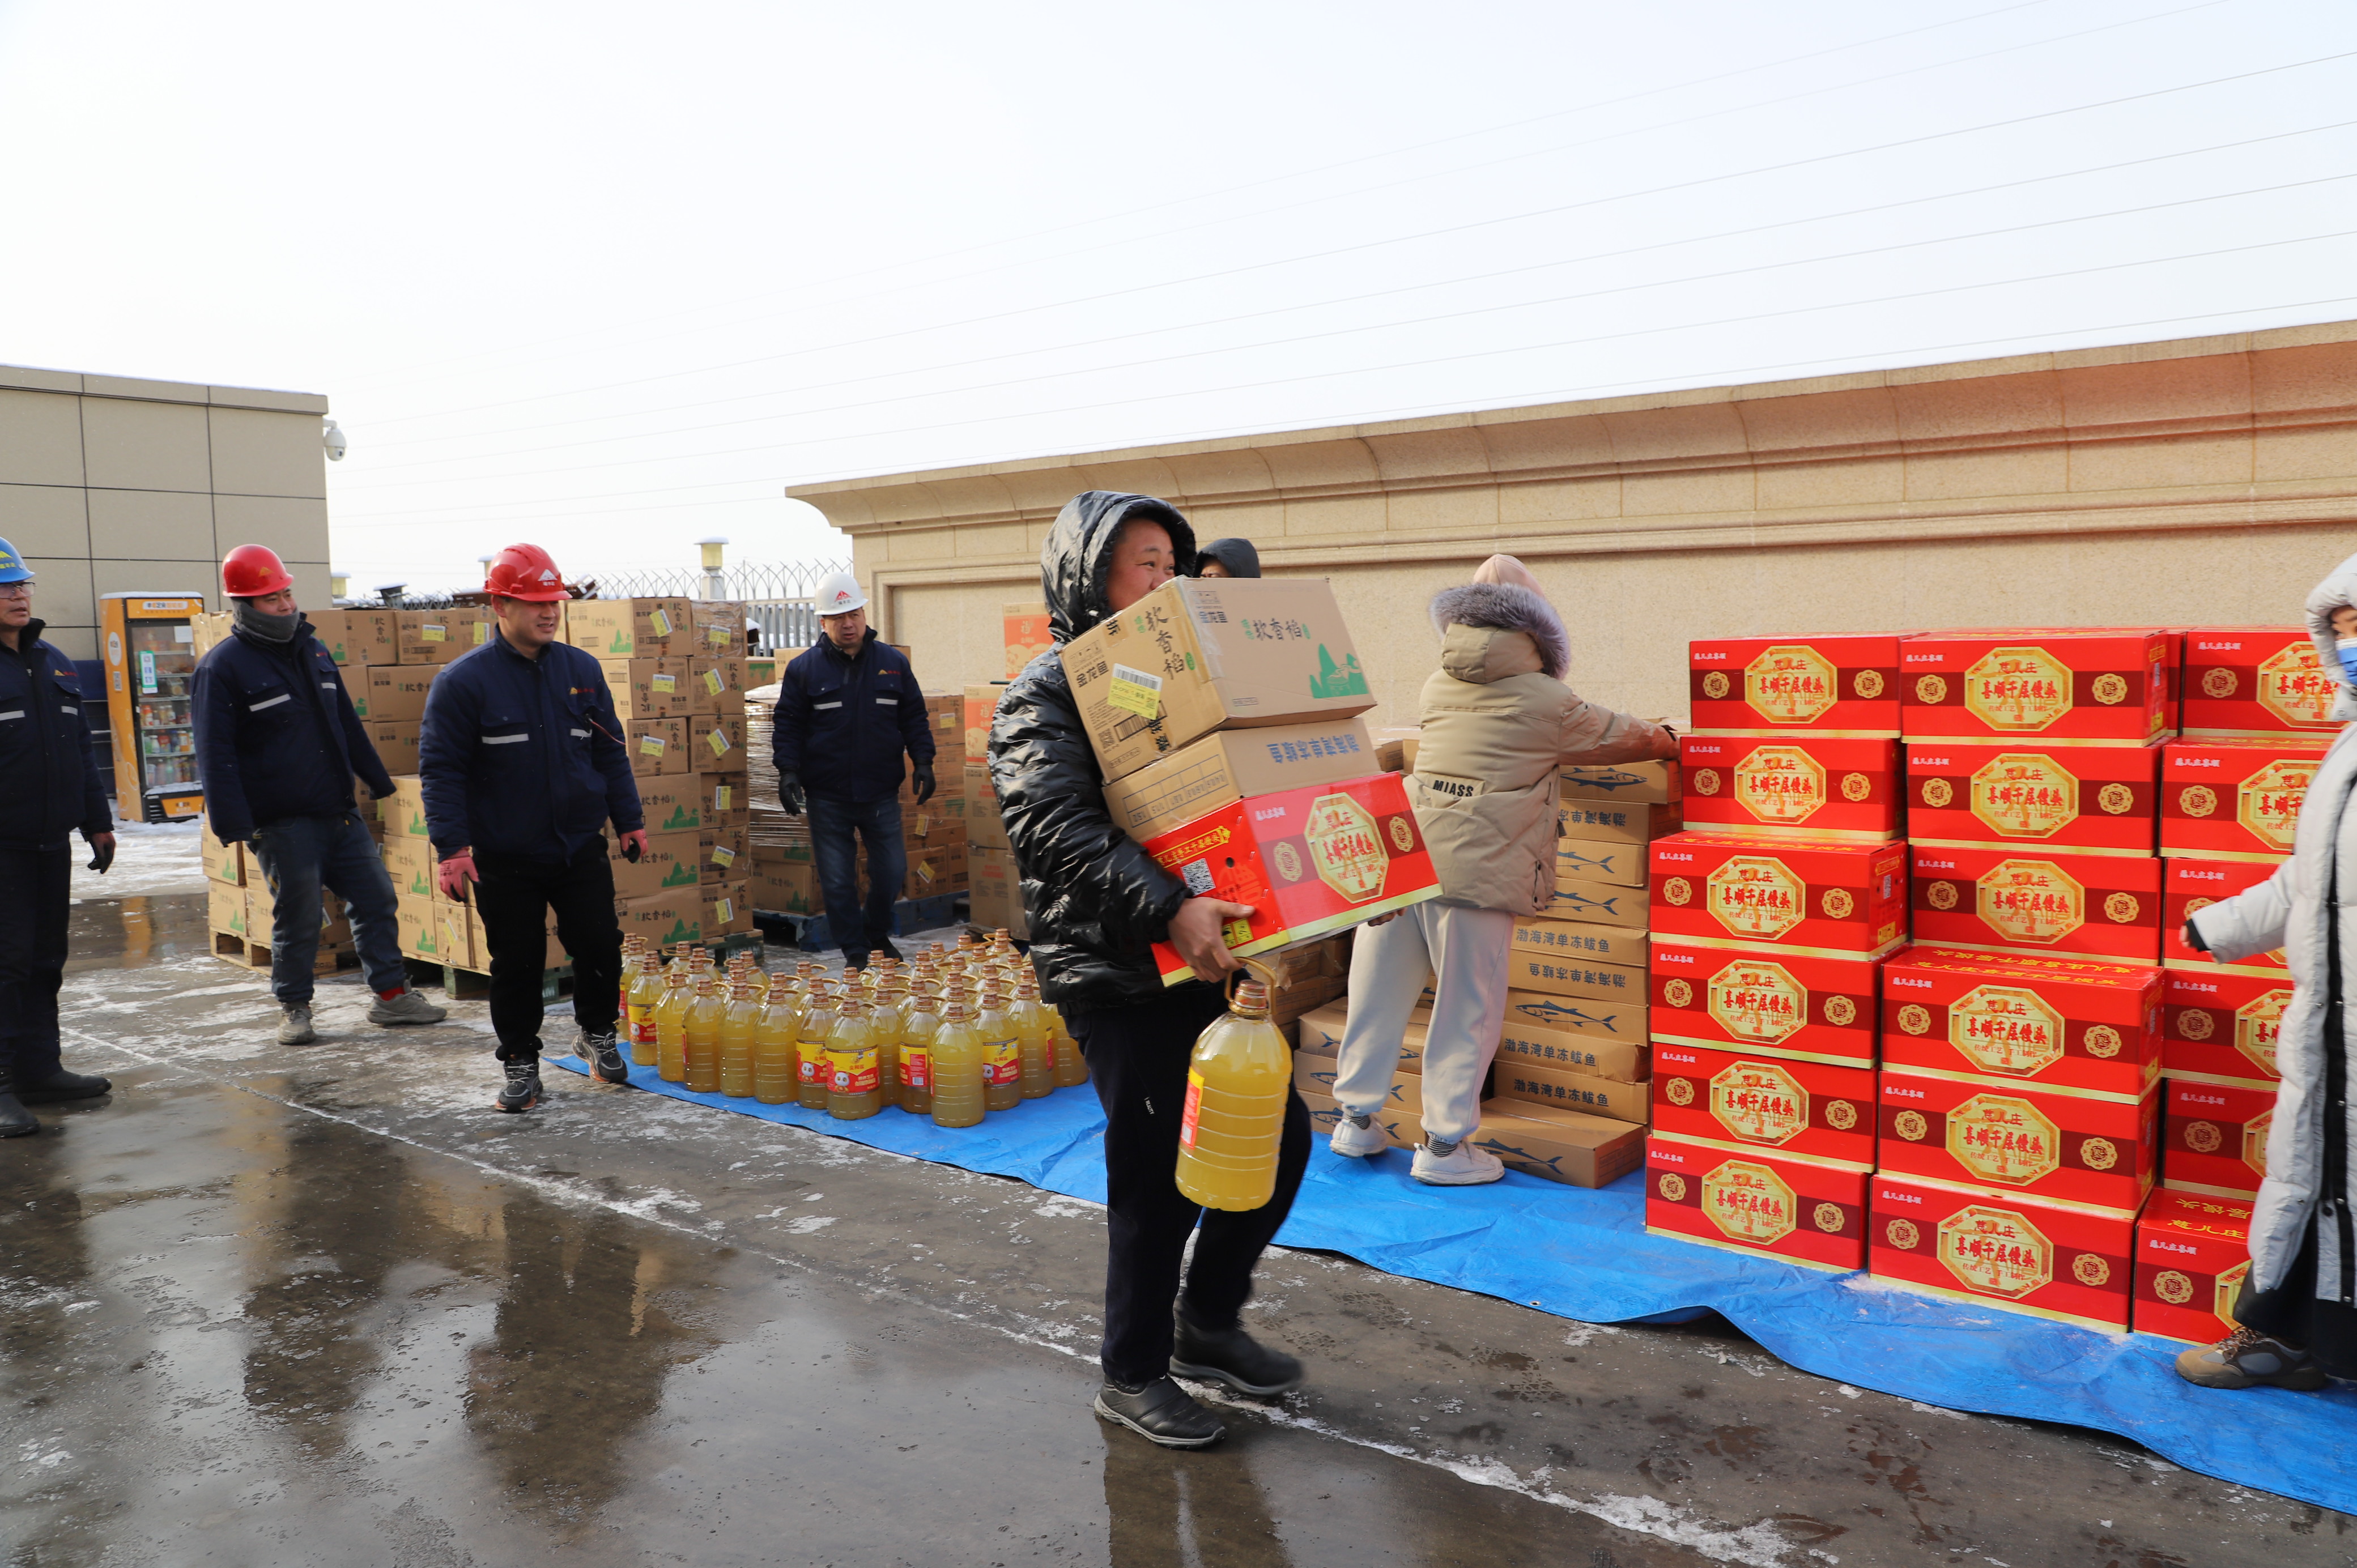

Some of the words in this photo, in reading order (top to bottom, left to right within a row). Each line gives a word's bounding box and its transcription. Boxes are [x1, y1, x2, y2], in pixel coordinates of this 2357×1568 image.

[1199, 611, 1228, 623] 金龙鱼
[1253, 617, 1303, 641] 软香稻
[1145, 606, 1185, 680] 软香稻
[1077, 661, 1109, 688] 金龙鱼
[1759, 676, 1824, 694] 喜顺千层馒头
[1981, 680, 2057, 699] 喜顺千层馒头
[1433, 779, 1474, 797] MIASS
[1749, 775, 1813, 794] 喜顺千层馒头
[1987, 785, 2063, 807] 喜顺千层馒头
[1323, 831, 1375, 865] 喜顺千层馒头
[1723, 885, 1792, 909] 喜顺千层馒头
[1993, 890, 2070, 913] 喜顺千层馒头
[1516, 928, 1610, 953] 渤海湾单冻鲅鱼
[1529, 963, 1626, 988] 渤海湾单冻鲅鱼
[1724, 989, 1792, 1014] 喜顺千层馒头
[1966, 1017, 2047, 1045] 喜顺千层馒头
[1504, 1038, 1597, 1066] 渤海湾单冻鲅鱼
[1514, 1079, 1609, 1107] 渤海湾单冻鲅鱼
[1725, 1090, 1794, 1117] 喜顺千层馒头
[1963, 1126, 2043, 1155] 喜顺千层馒头
[1716, 1187, 1782, 1217] 喜顺千层馒头
[1955, 1235, 2036, 1269] 喜顺千层馒头
